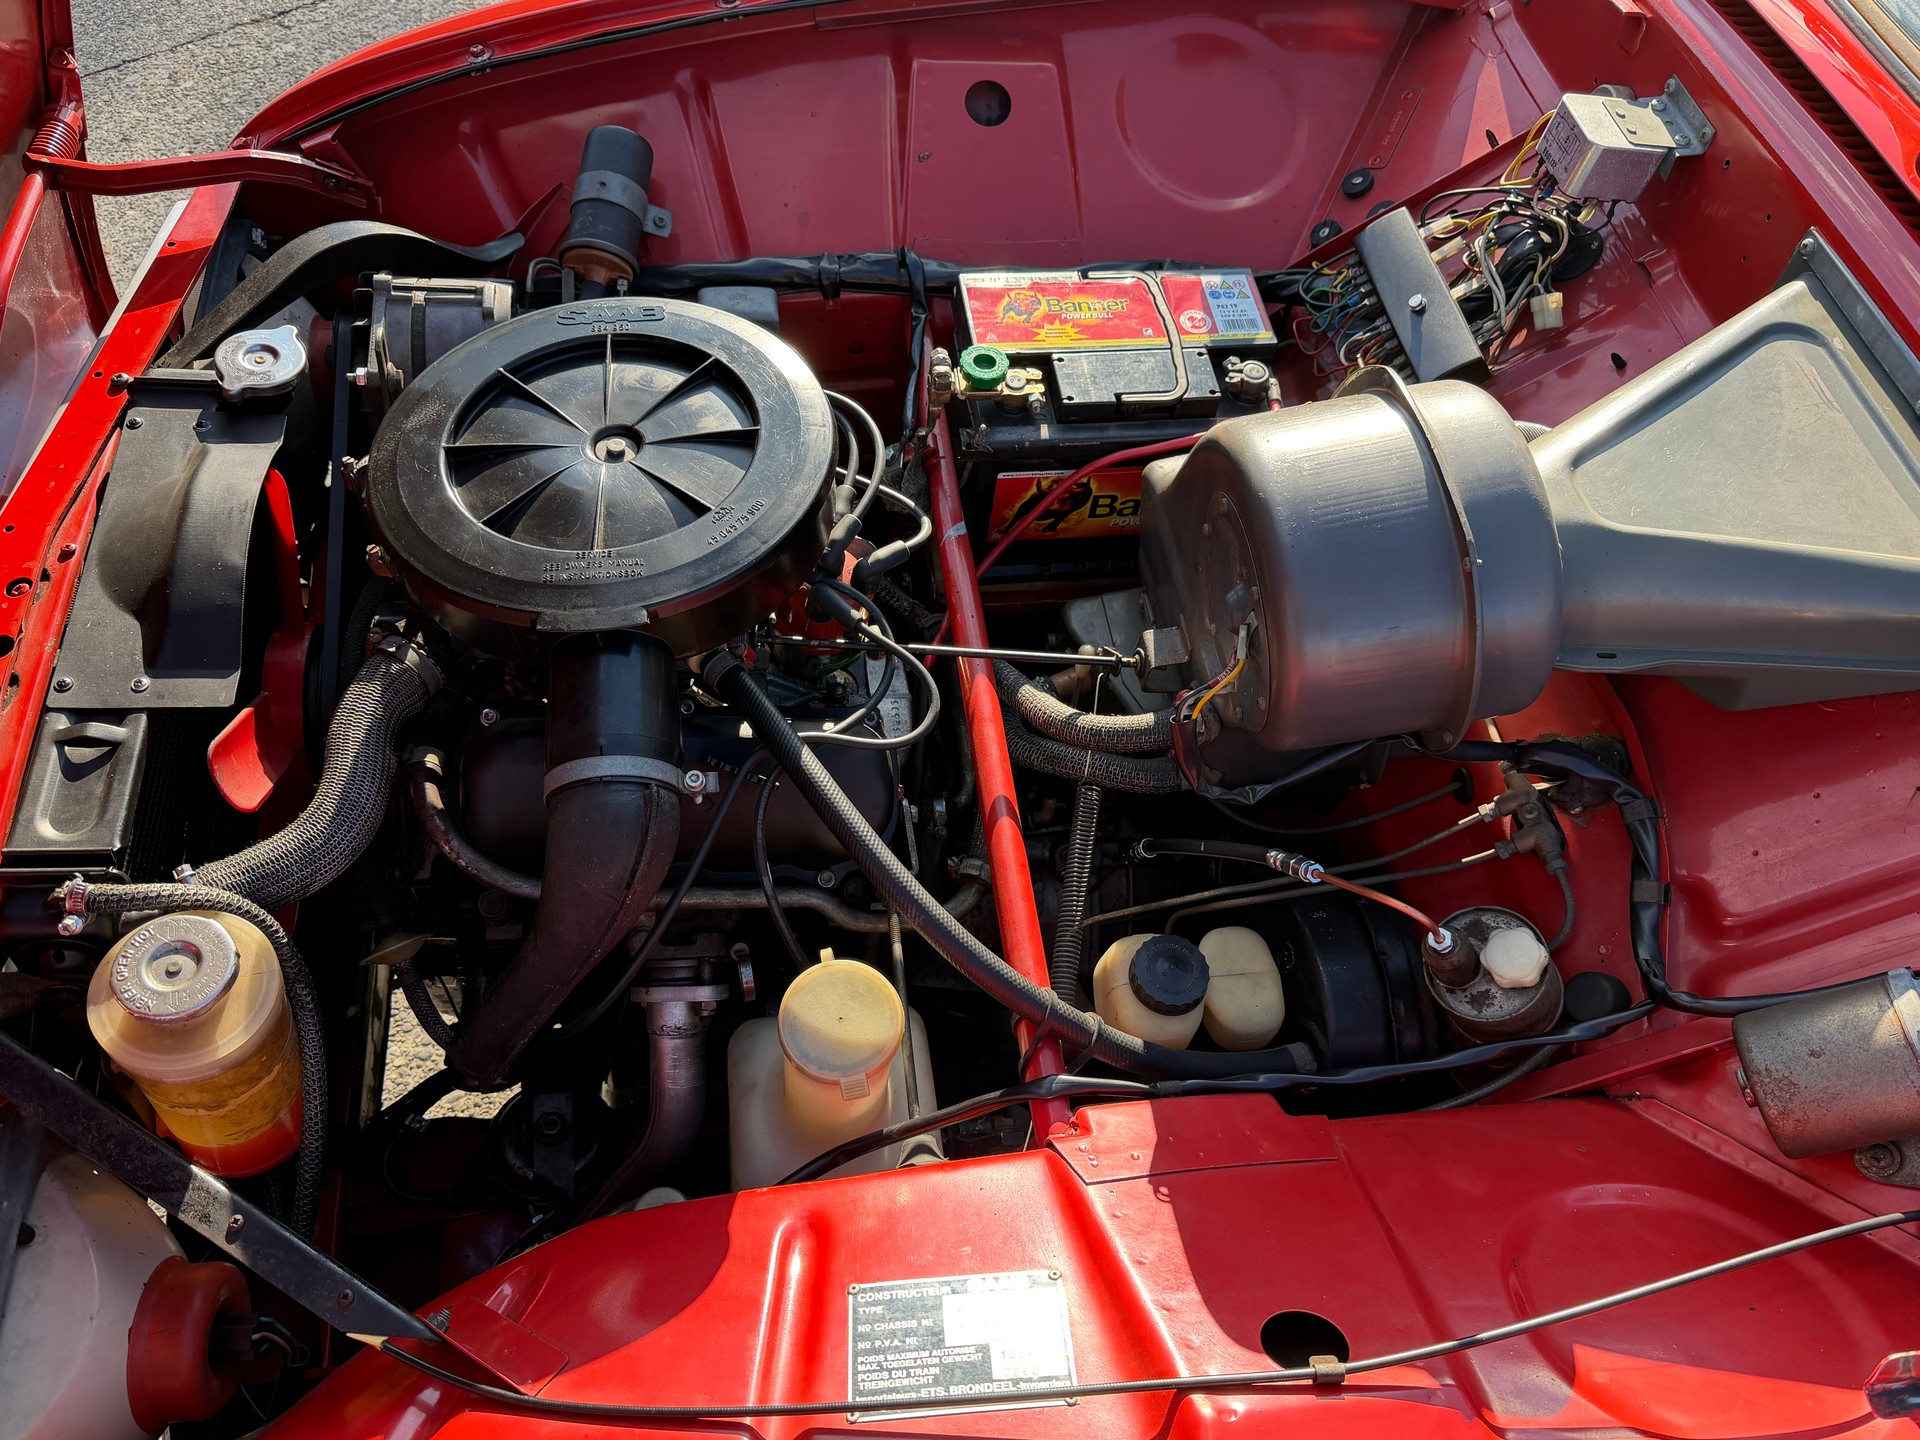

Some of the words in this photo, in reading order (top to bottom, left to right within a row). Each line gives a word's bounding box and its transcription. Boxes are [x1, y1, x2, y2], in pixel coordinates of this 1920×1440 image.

[1047, 298, 1128, 313] Banner
[557, 305, 666, 325] SAAB
[543, 562, 561, 572] SEE
[564, 560, 603, 570] OWNERS
[607, 558, 645, 567] MANUAL
[542, 574, 555, 584] SE
[131, 926, 155, 948] HOT
[115, 949, 134, 982] OPEN
[119, 983, 157, 1012] NEVER
[857, 1287, 952, 1302] CONSTRUCTEUR
[858, 1306, 883, 1315] TYPE
[873, 1320, 918, 1331] CHASSIS
[874, 1339, 903, 1348] P.V.A.
[857, 1354, 885, 1363] POIDS
[887, 1350, 930, 1361] MAXIMUM
[857, 1363, 880, 1371] MAX.
[882, 1357, 940, 1369] TOEGELATEN
[942, 1353, 984, 1363] GEWICHT
[857, 1372, 889, 1381] POIDS
[891, 1370, 907, 1378] DU
[909, 1367, 940, 1377] TRAIN
[858, 1376, 935, 1390] TREINGEWICHT
